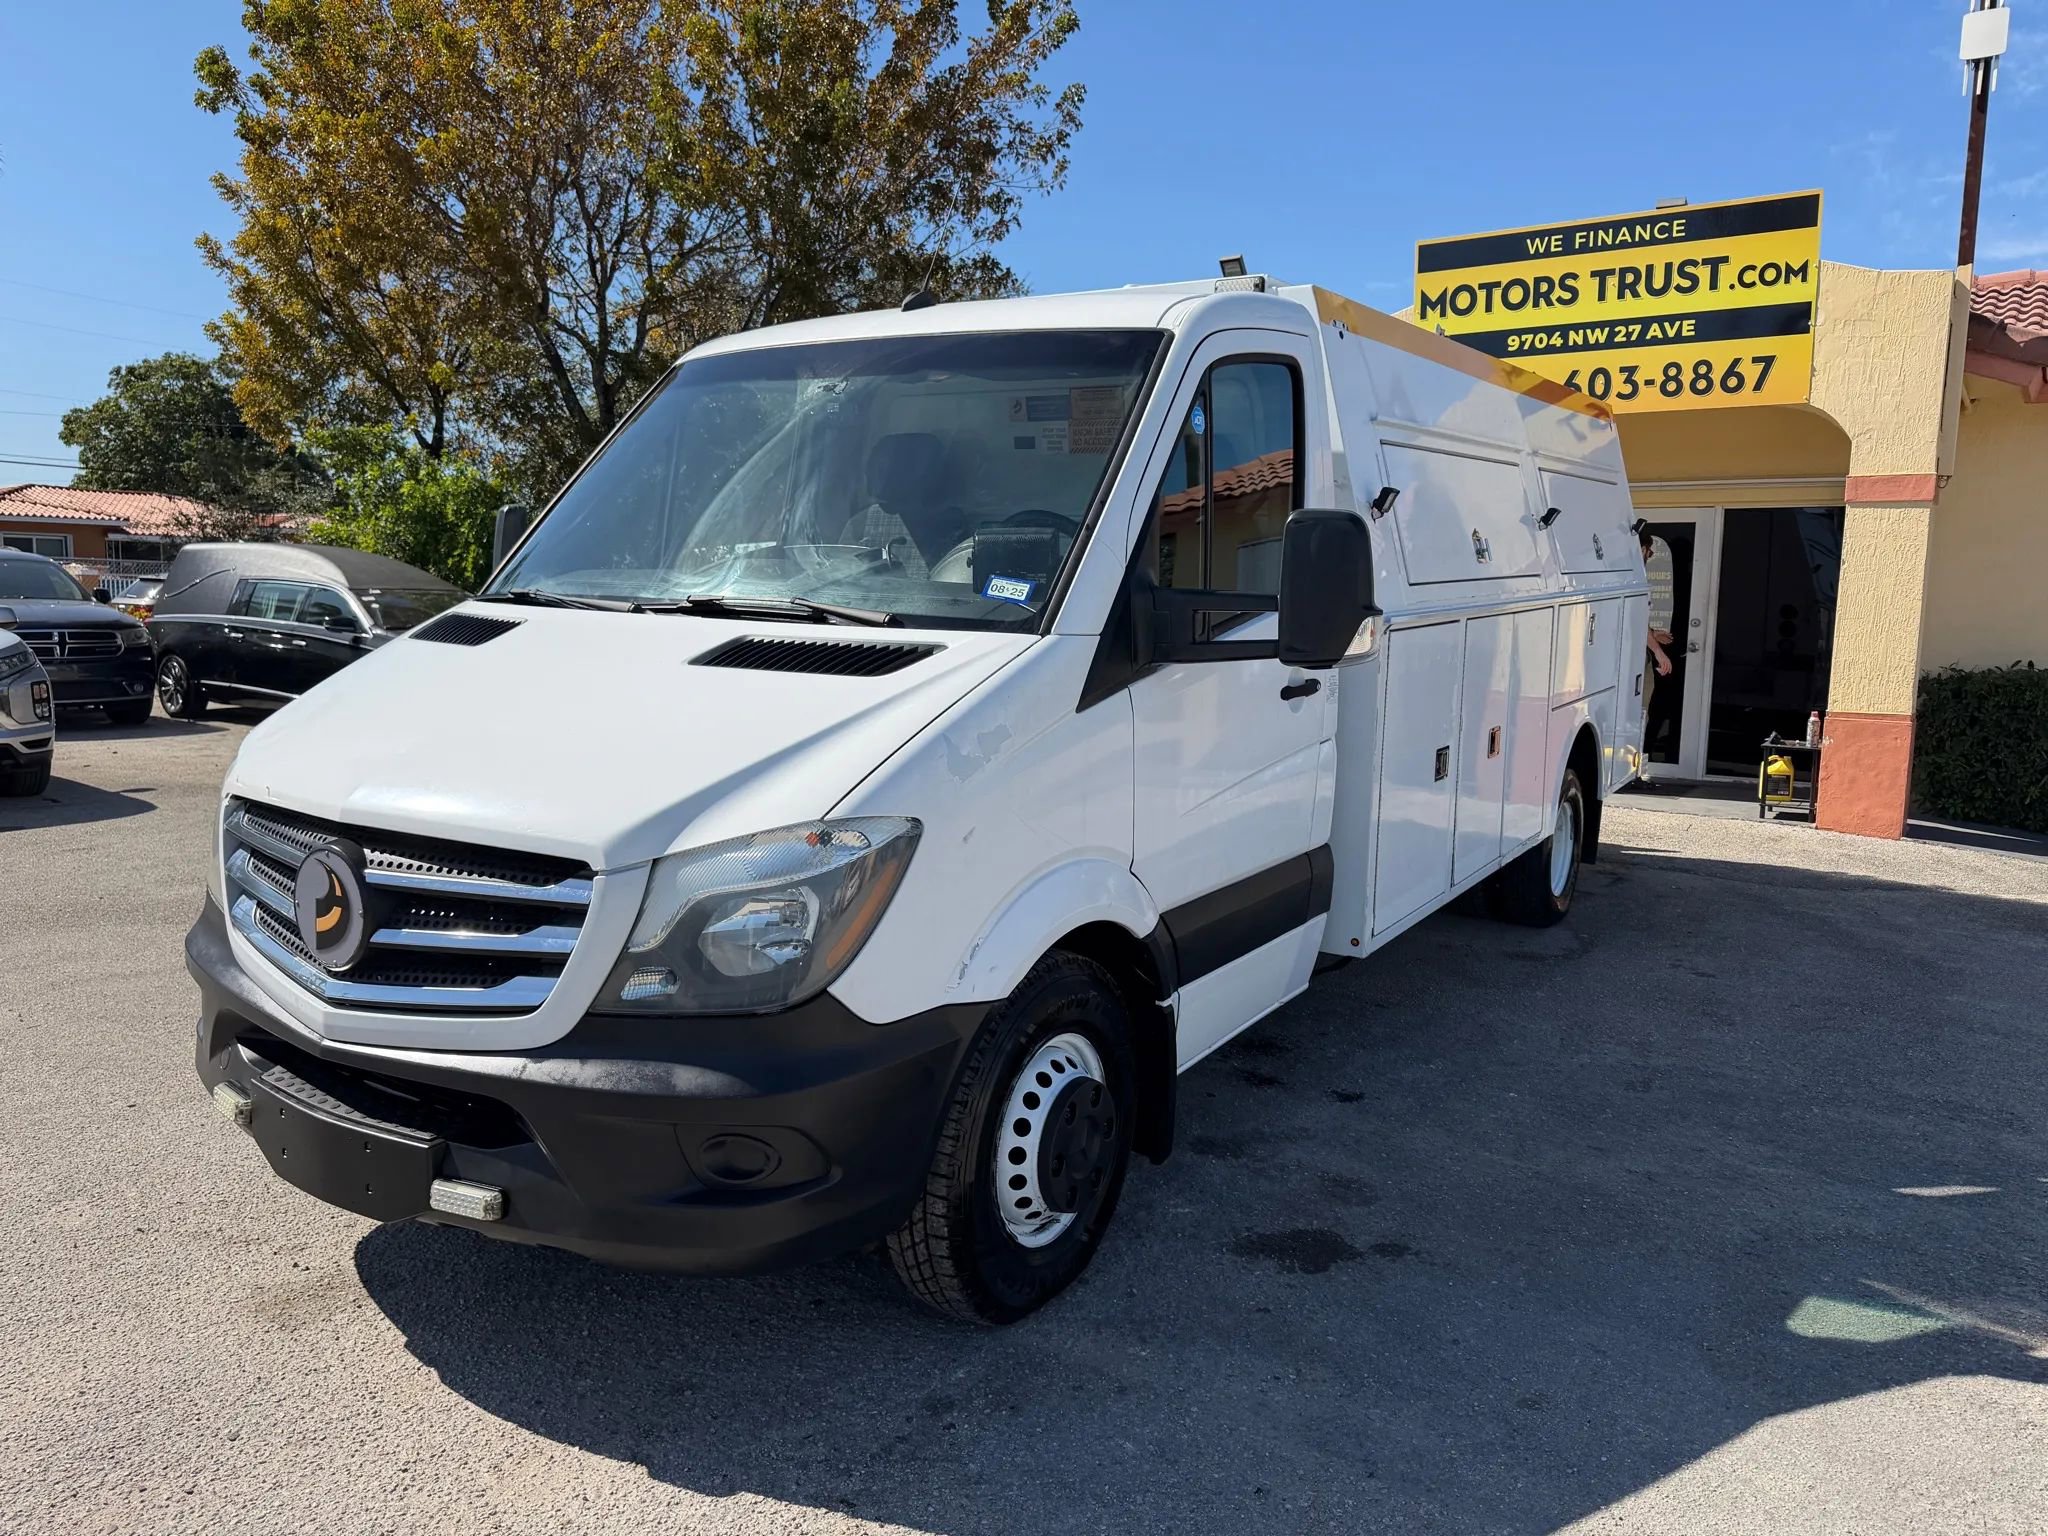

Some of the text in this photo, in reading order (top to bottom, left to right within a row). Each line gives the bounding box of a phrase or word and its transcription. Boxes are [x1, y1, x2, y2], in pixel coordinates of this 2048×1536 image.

[1526, 219, 1687, 254] WE FINANCE
[1420, 271, 1581, 320] MOTORS
[1507, 319, 1697, 351] 9704 NW 27 AVE
[1563, 355, 1778, 402] 603-8867
